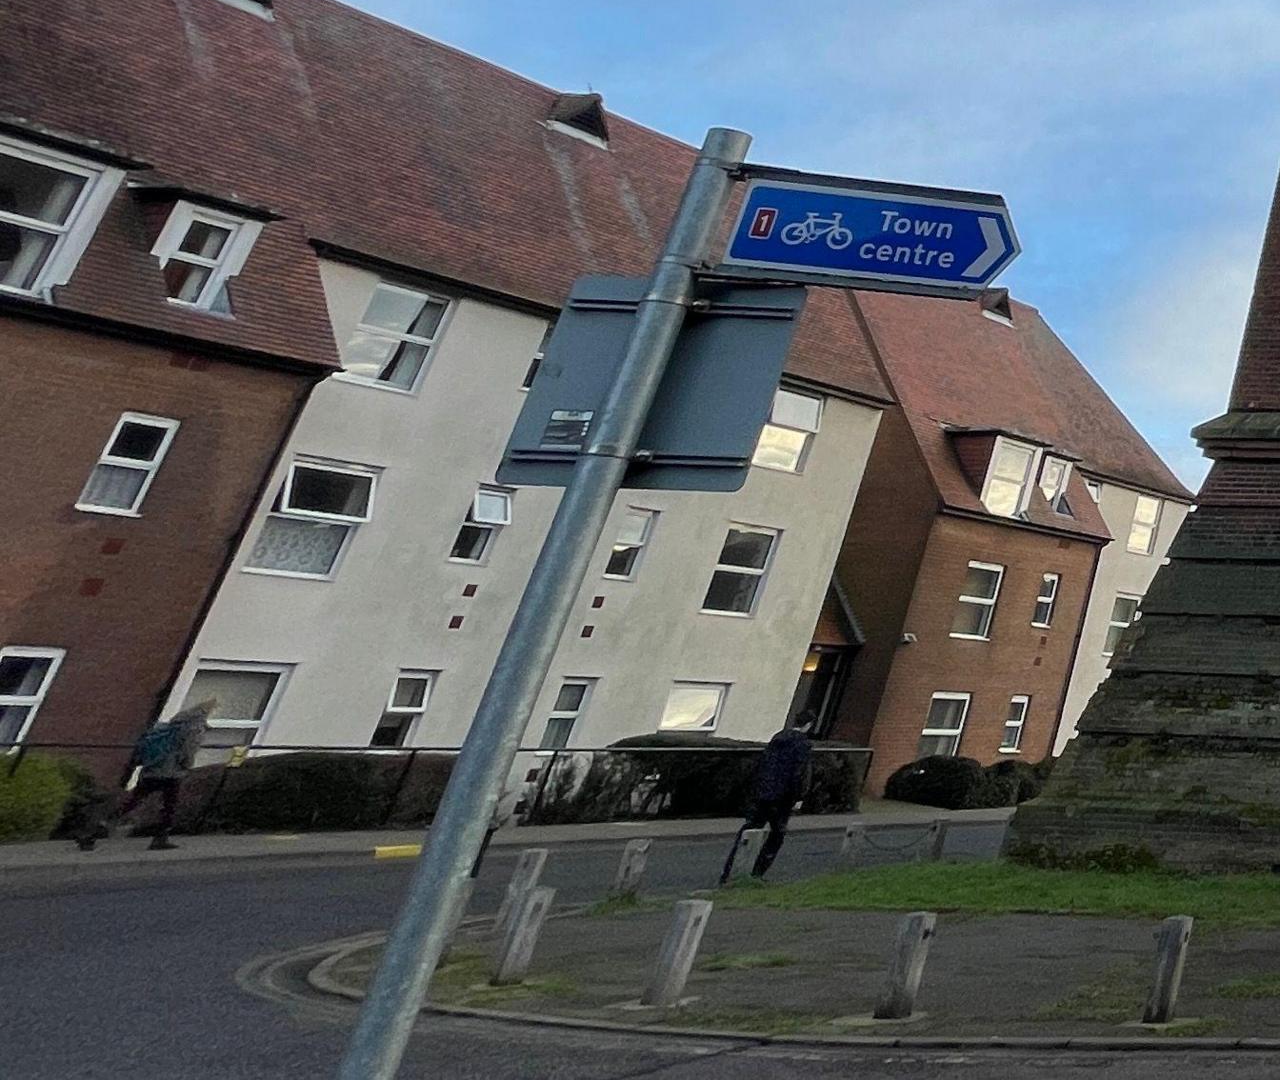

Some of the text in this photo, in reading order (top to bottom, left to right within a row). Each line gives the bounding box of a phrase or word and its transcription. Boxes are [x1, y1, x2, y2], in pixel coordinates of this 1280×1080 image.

[759, 214, 770, 232] 1
[881, 210, 953, 239] Town
[859, 242, 955, 268] centre
